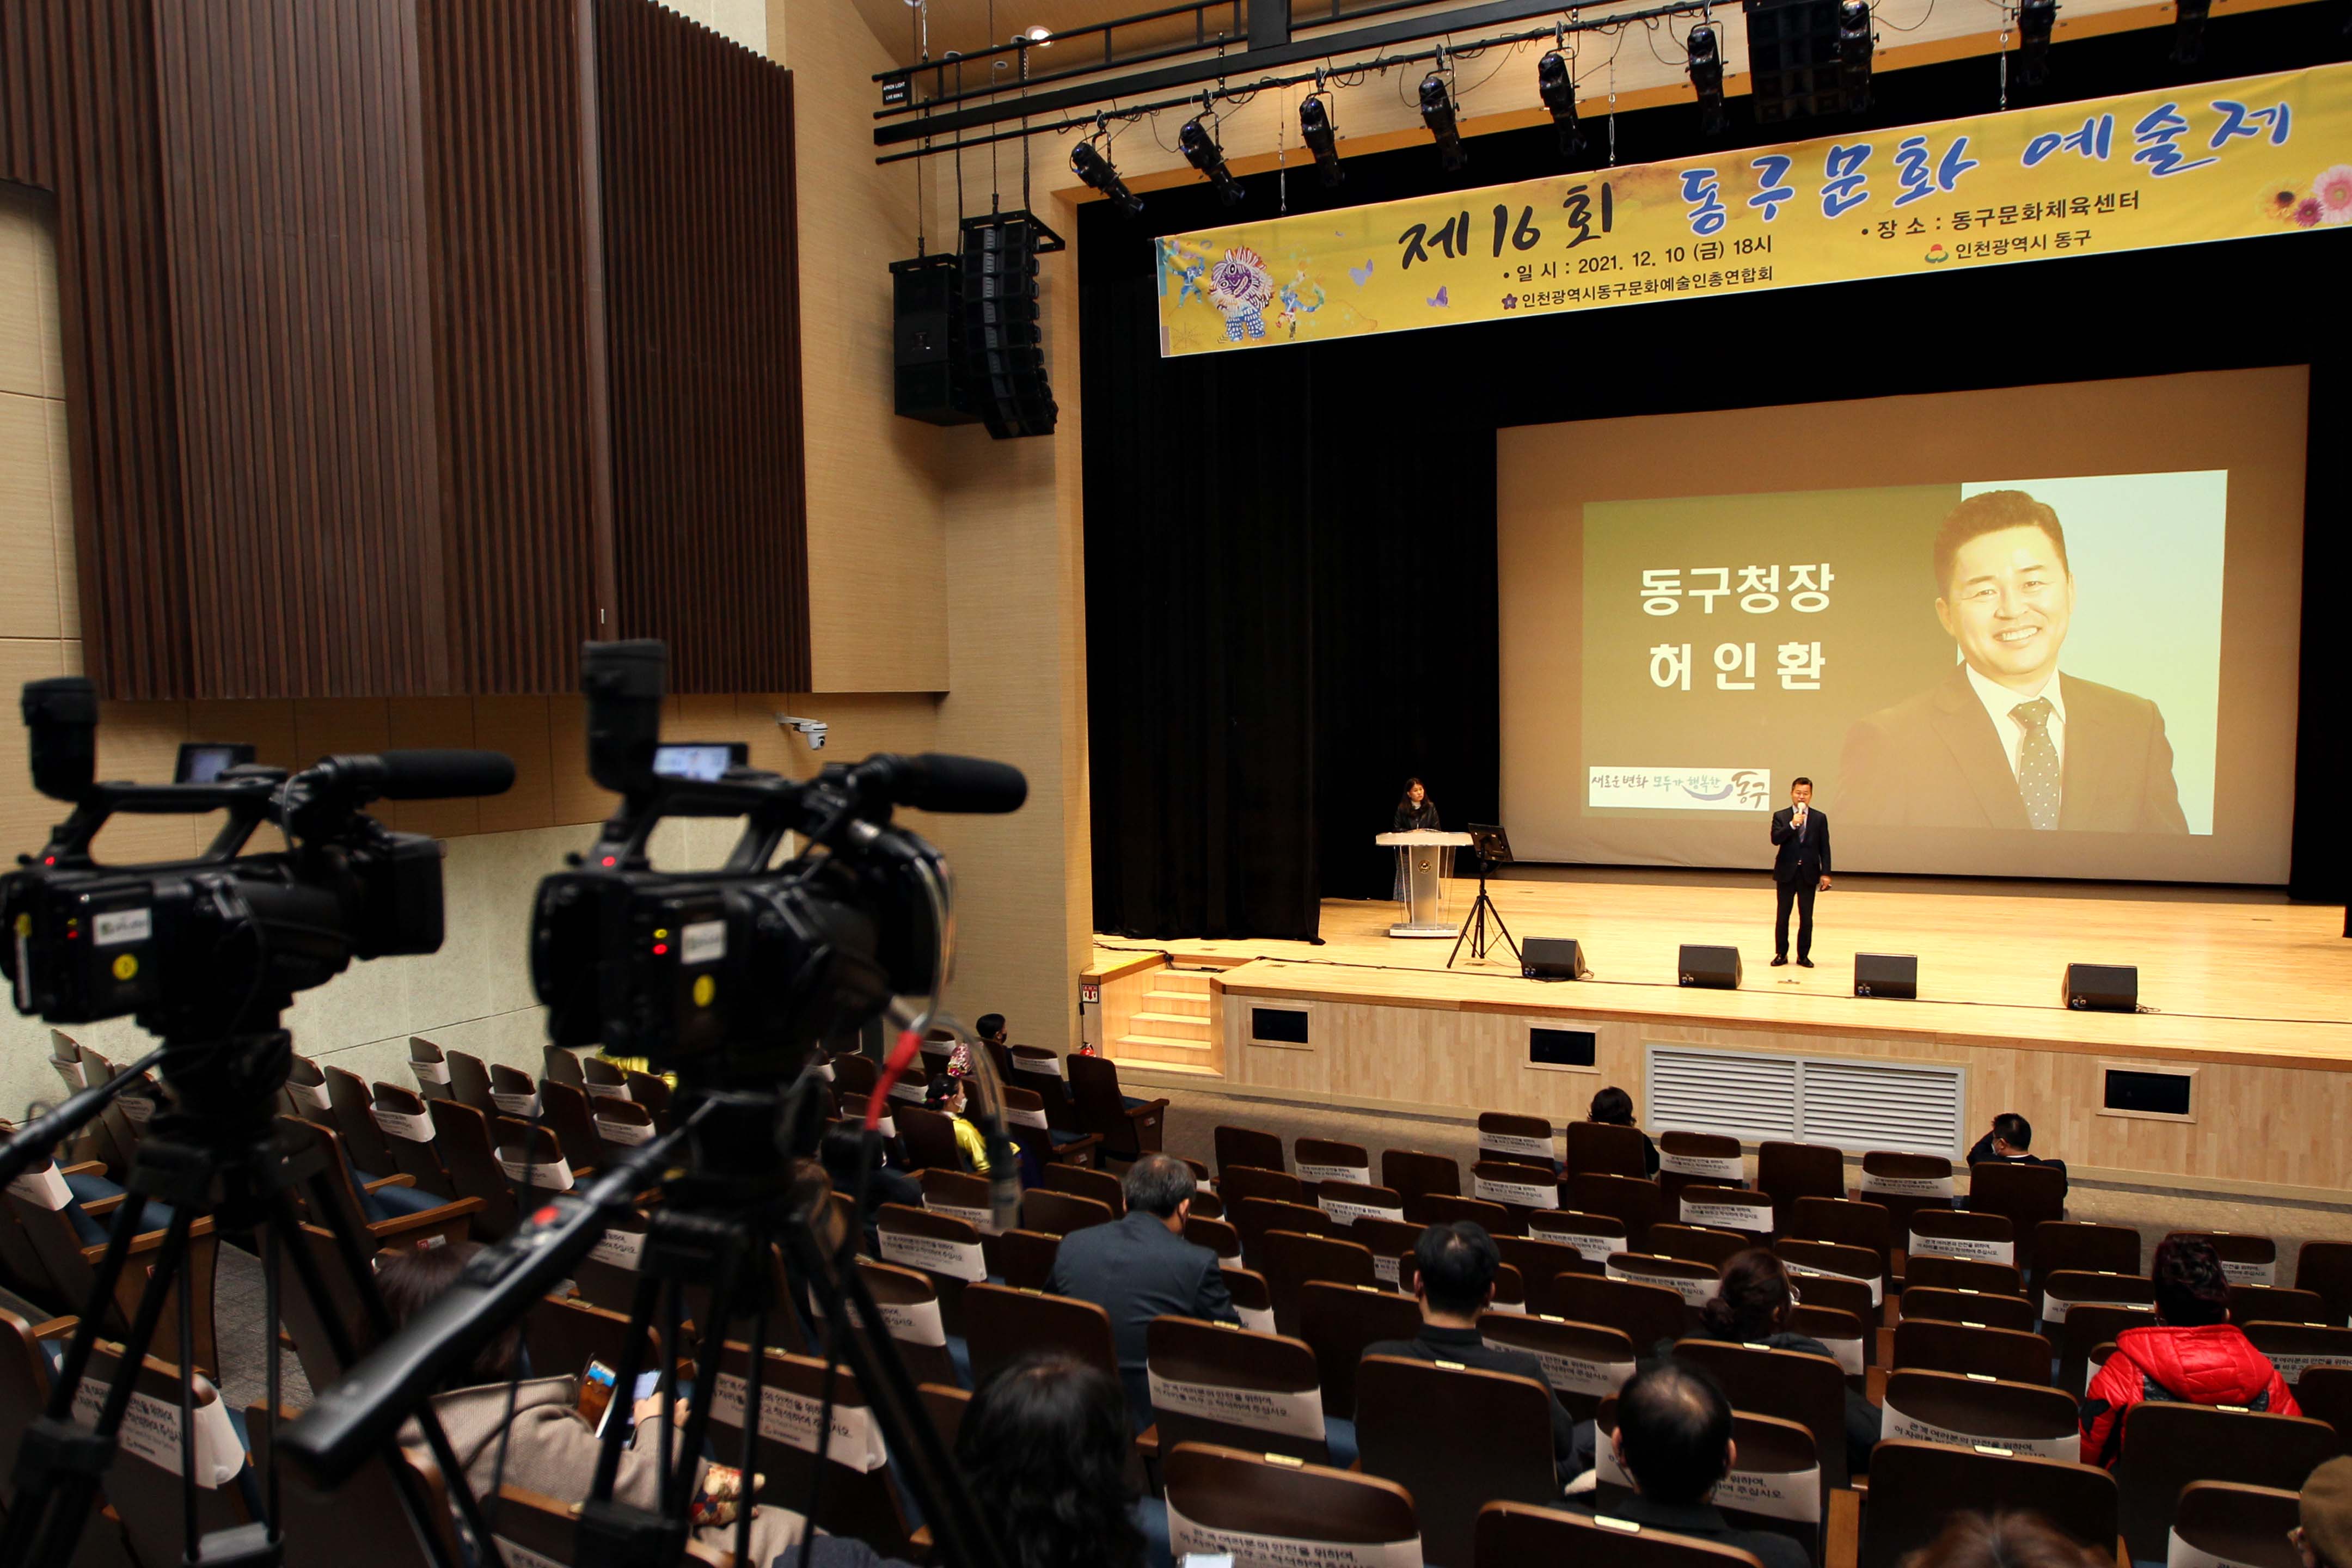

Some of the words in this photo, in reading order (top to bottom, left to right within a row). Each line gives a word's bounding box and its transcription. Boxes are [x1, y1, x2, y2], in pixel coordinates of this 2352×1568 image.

[2021, 100, 2292, 177] 예술제
[1951, 189, 2140, 231] 동구문화체육센터
[1578, 255, 1624, 274] 2021.
[1632, 250, 1656, 267] 12.
[1665, 246, 1685, 263] 10
[1693, 240, 1725, 261] (금)
[1734, 234, 1772, 255] 18시
[1956, 234, 2047, 260] 인천광역시
[2054, 229, 2092, 249] 동구
[1522, 266, 1773, 309] 인천광역시동구문화예술인총연합회
[1640, 563, 1835, 616] 동구청장
[1731, 770, 1770, 808] 동구
